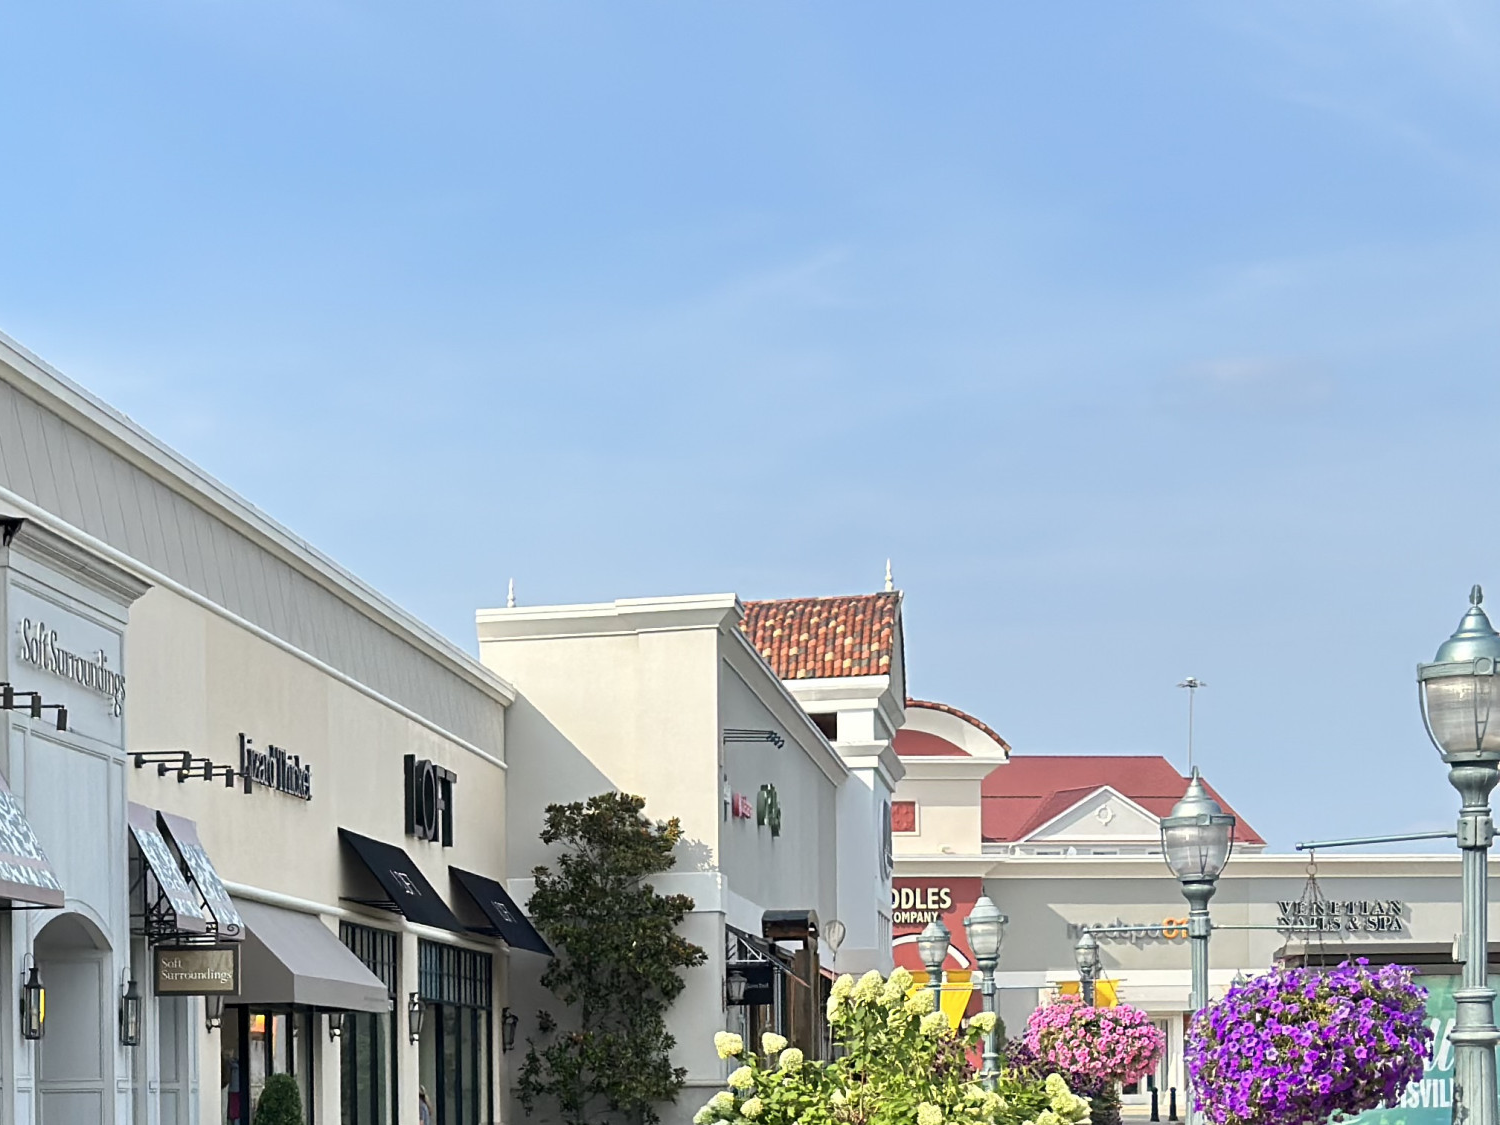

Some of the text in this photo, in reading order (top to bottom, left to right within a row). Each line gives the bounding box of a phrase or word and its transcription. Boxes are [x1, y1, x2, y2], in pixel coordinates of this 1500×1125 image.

[20, 617, 126, 718] Soft Surroundings
[403, 754, 457, 847] LOFT
[891, 887, 952, 910] ODLES
[1277, 900, 1403, 916] VENETIAN
[892, 911, 939, 924] OMPANY
[1277, 915, 1403, 932] NAILS & SPA
[161, 957, 183, 969] Soft
[161, 967, 233, 985] Surroundings
